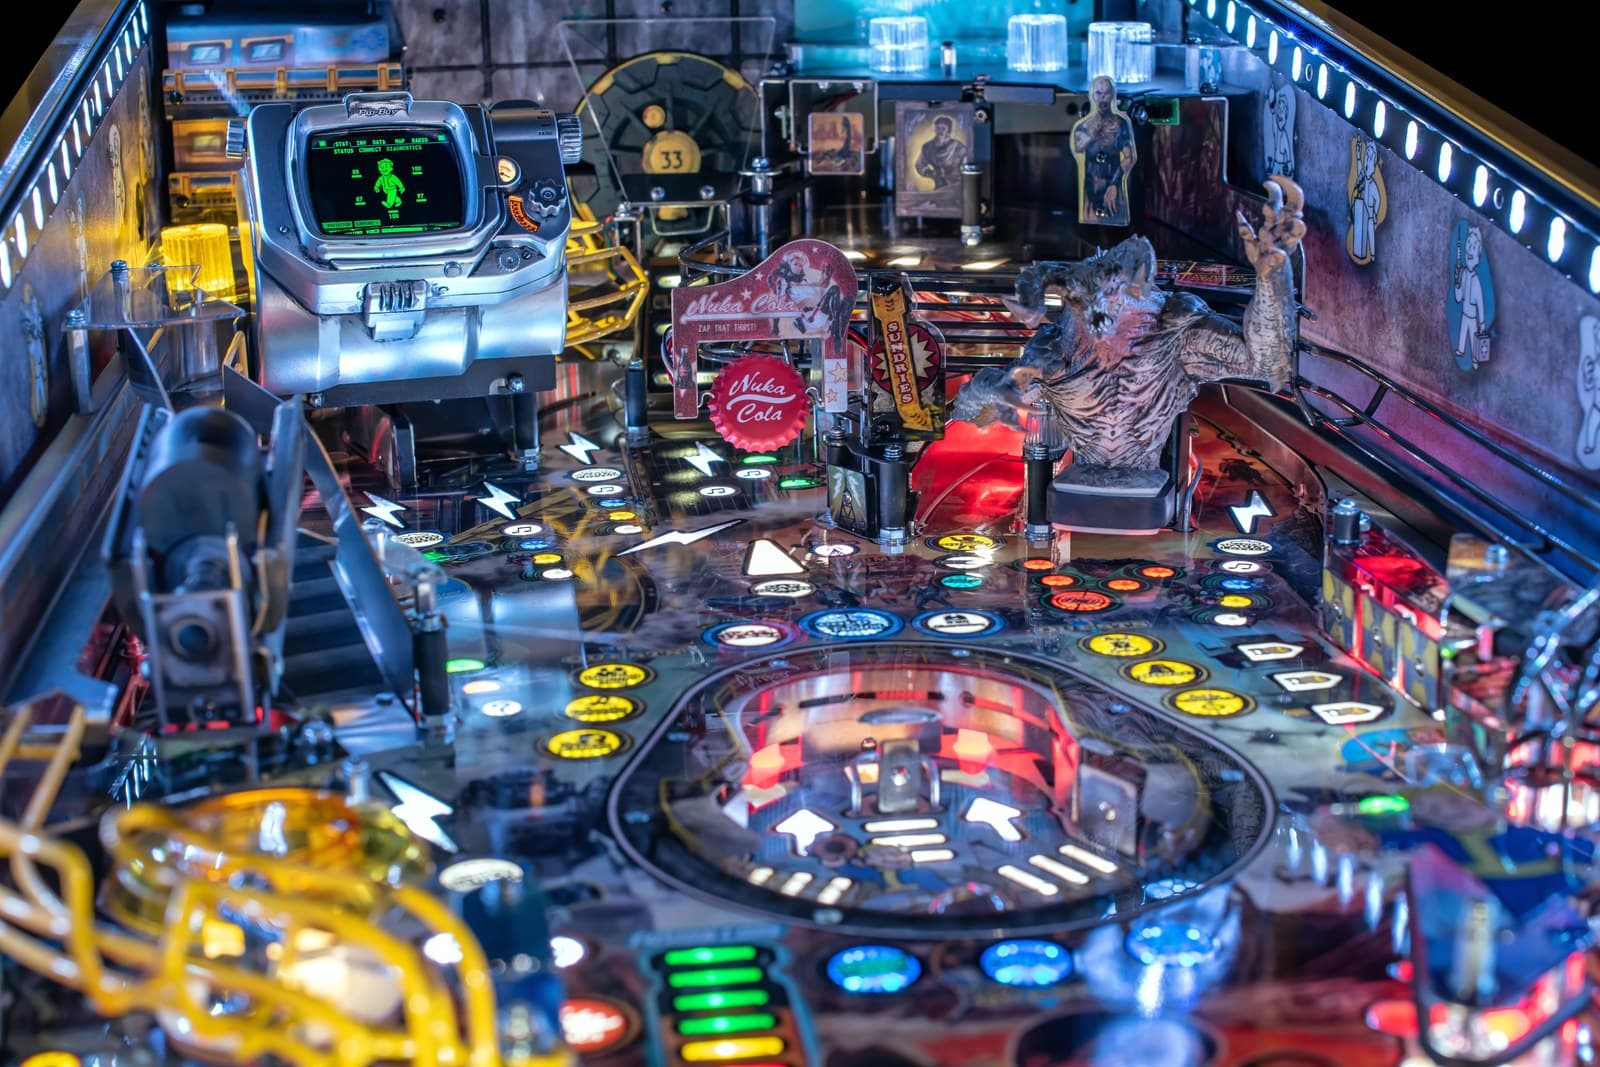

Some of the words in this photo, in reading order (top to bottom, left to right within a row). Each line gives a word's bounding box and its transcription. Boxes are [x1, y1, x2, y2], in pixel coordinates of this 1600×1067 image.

[660, 150, 683, 170] 33
[686, 291, 743, 317] Nuka
[751, 293, 795, 314] Cola
[698, 324, 711, 333] ZAP
[715, 323, 730, 332] THAT
[887, 321, 913, 404] SUNDRIES
[728, 371, 786, 396] Nuka
[736, 403, 783, 424] Cola
